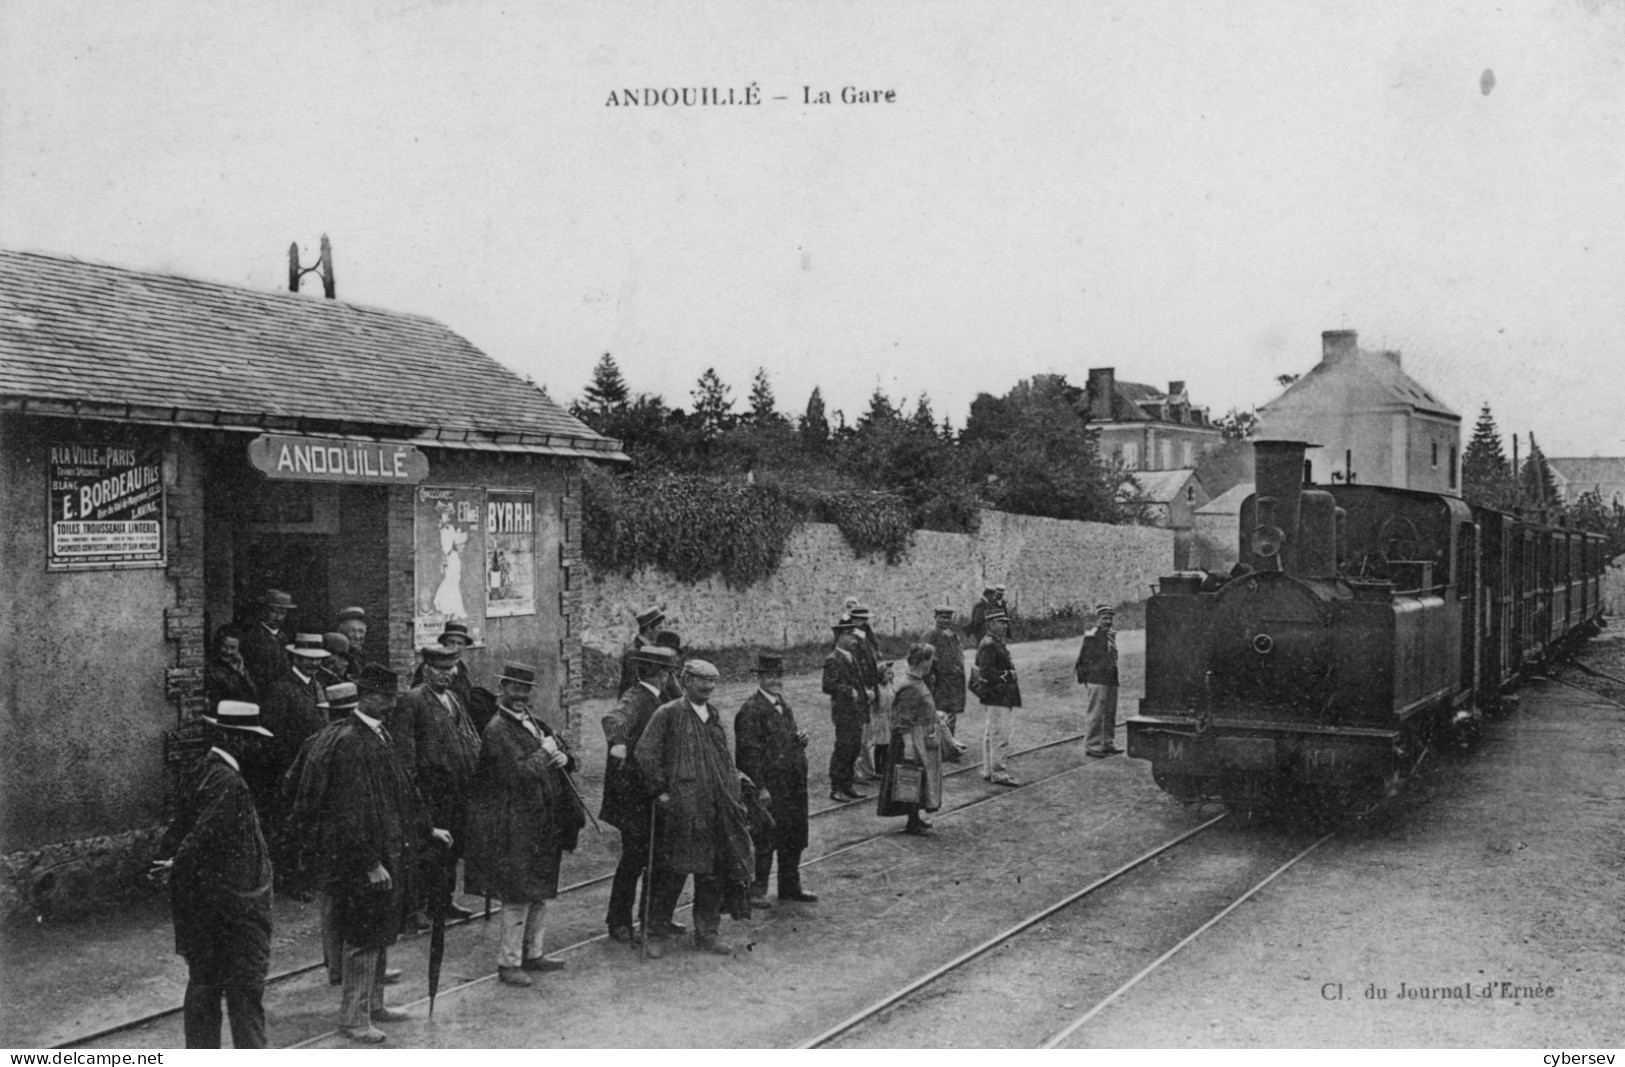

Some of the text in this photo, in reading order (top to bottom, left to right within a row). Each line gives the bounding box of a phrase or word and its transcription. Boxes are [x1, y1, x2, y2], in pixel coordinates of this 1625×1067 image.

[51, 447, 58, 464] A
[59, 447, 71, 464] LA
[72, 445, 99, 465] VILLE
[106, 447, 136, 469] PARIS
[277, 442, 408, 477] ANDOUILLÉ
[52, 481, 79, 490] BLANC
[63, 495, 78, 520] E.
[80, 467, 142, 519] BORDEAU
[143, 466, 159, 487] FILS
[131, 501, 158, 519] LAVAL
[488, 501, 532, 533] BYRRH
[57, 522, 157, 535] TOILES TROUSSEAUX LINGERIE
